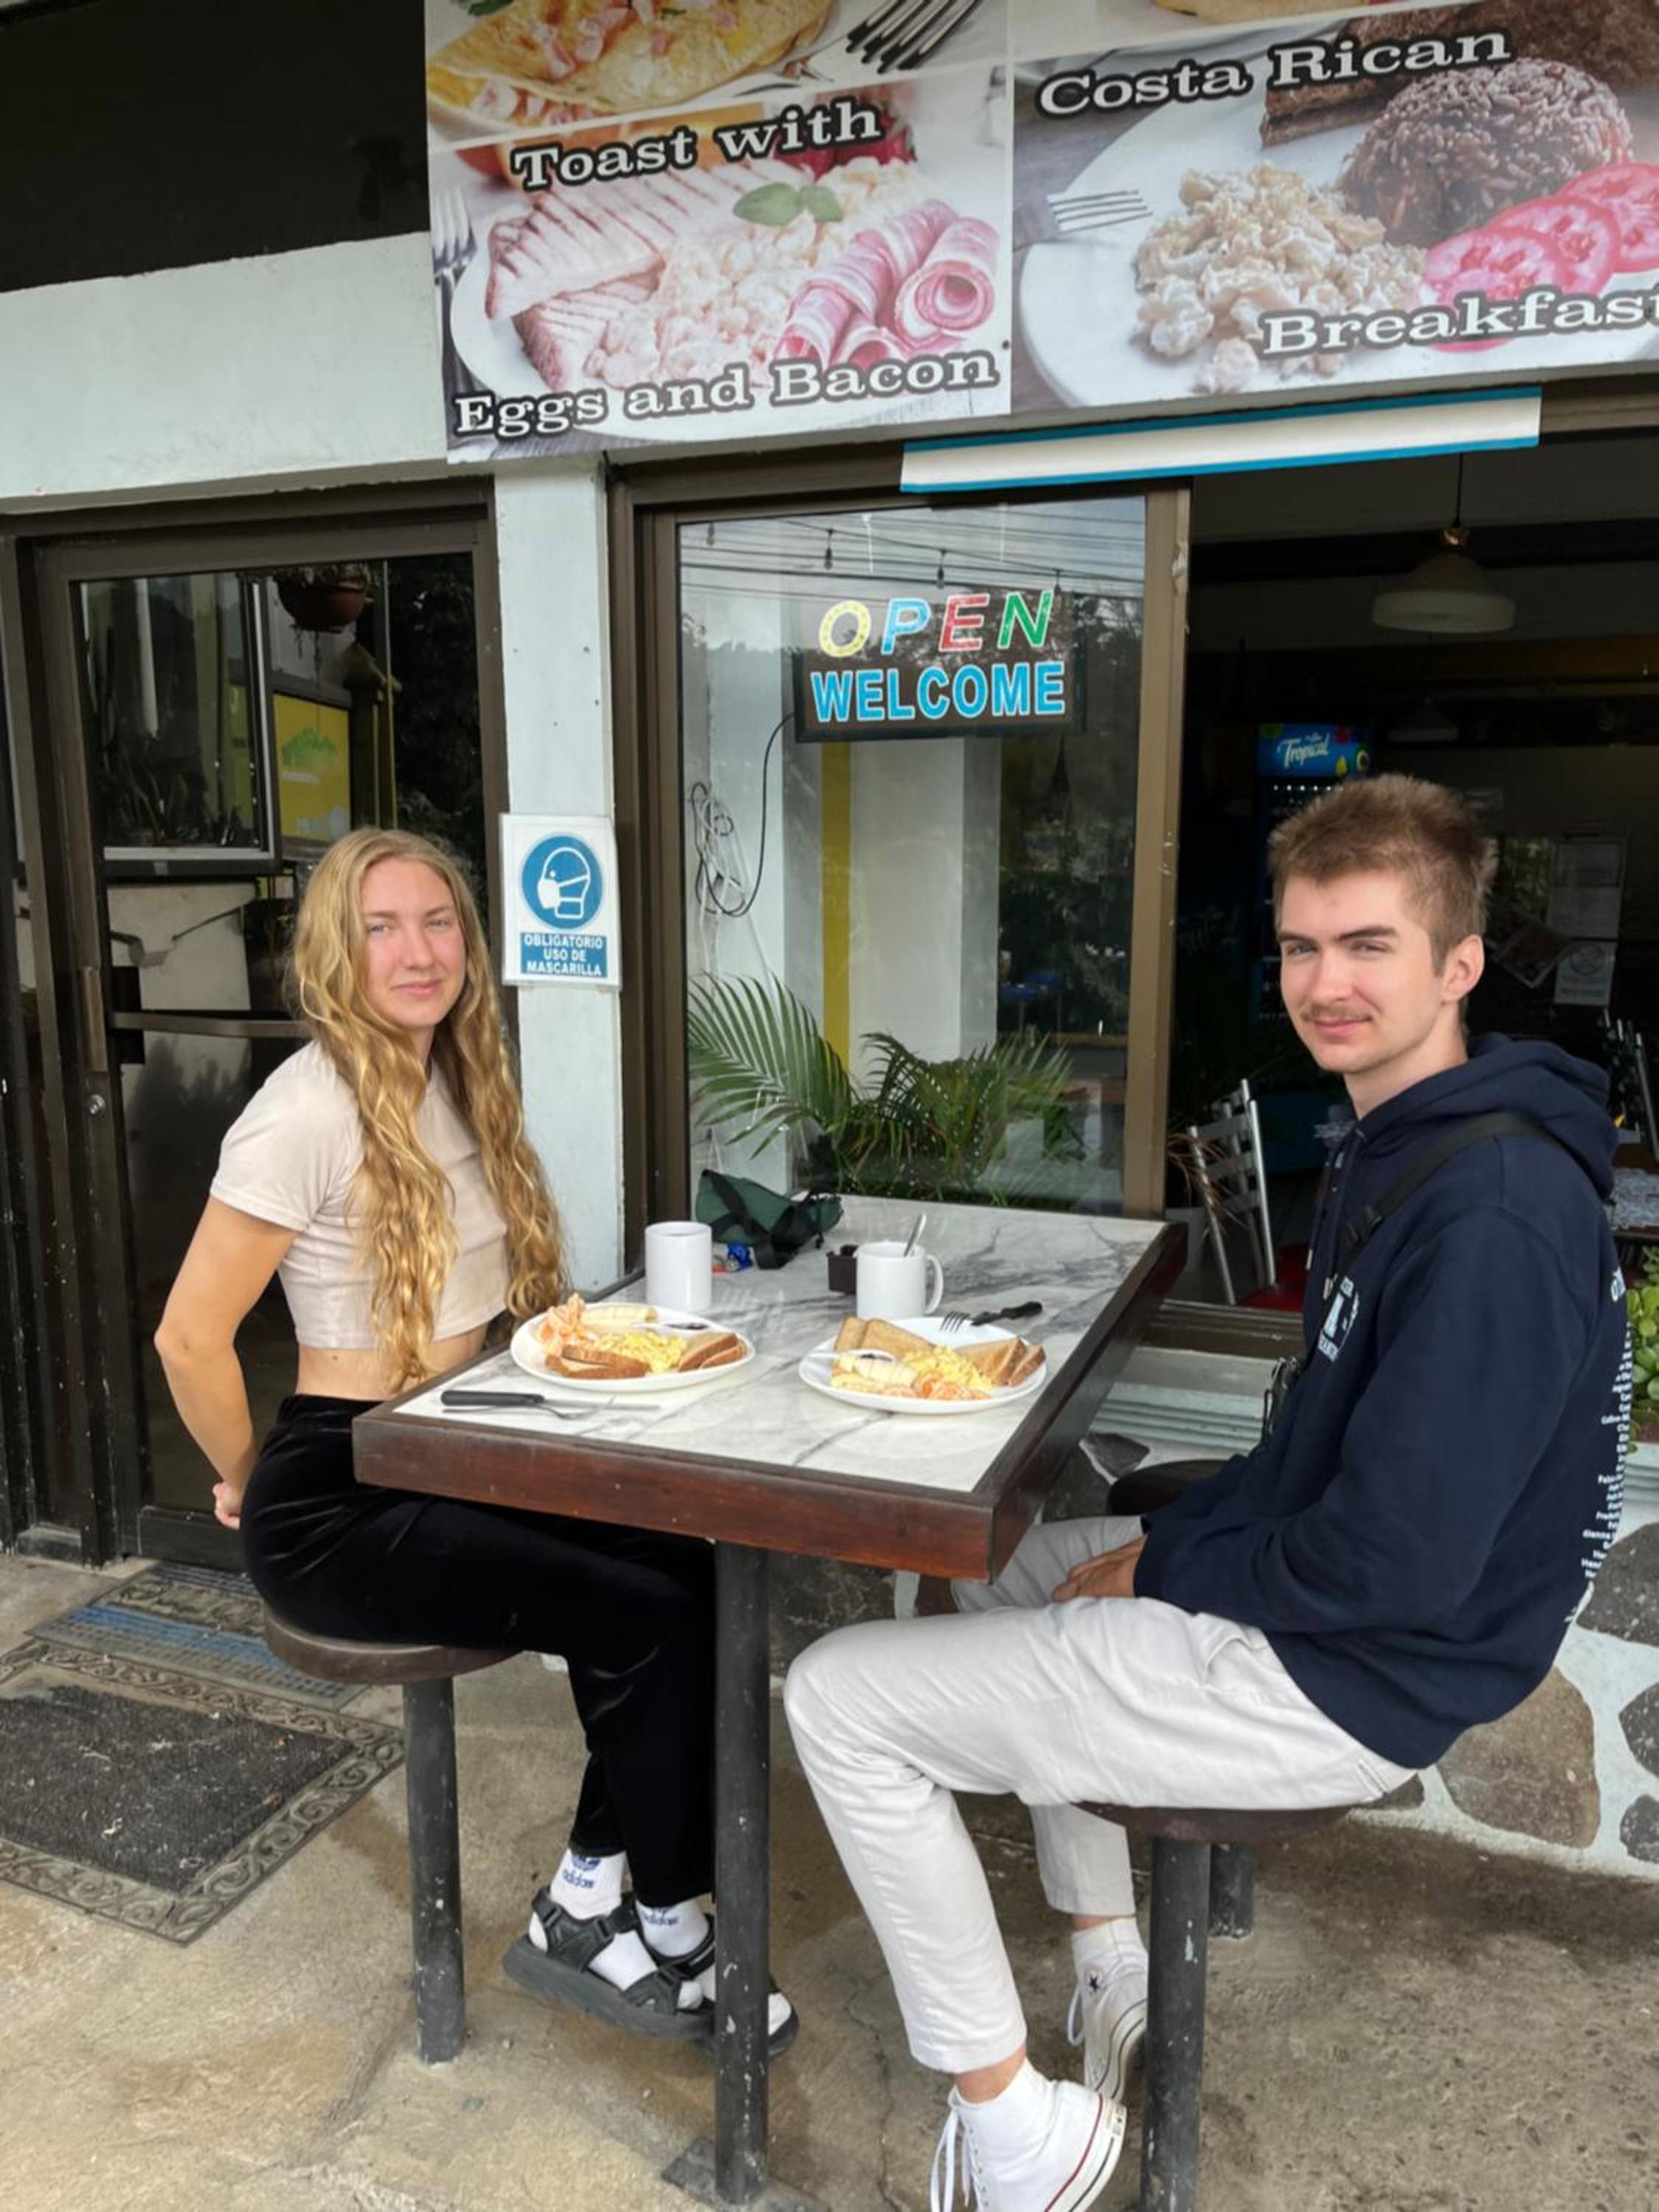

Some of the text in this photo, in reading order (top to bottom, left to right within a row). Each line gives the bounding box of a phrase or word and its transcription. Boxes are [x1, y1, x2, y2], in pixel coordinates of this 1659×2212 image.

[1039, 31, 1511, 116] Costa Rican
[512, 101, 882, 190] Toast with
[455, 352, 995, 437] Eggs and Bacon
[818, 590, 1054, 658] OPEN
[810, 661, 1065, 723] WELCOME
[1276, 732, 1330, 769] Tropical
[524, 933, 603, 950] OBLIGATORIO
[526, 960, 602, 975] MASCARILLA
[543, 947, 588, 962] USO DE
